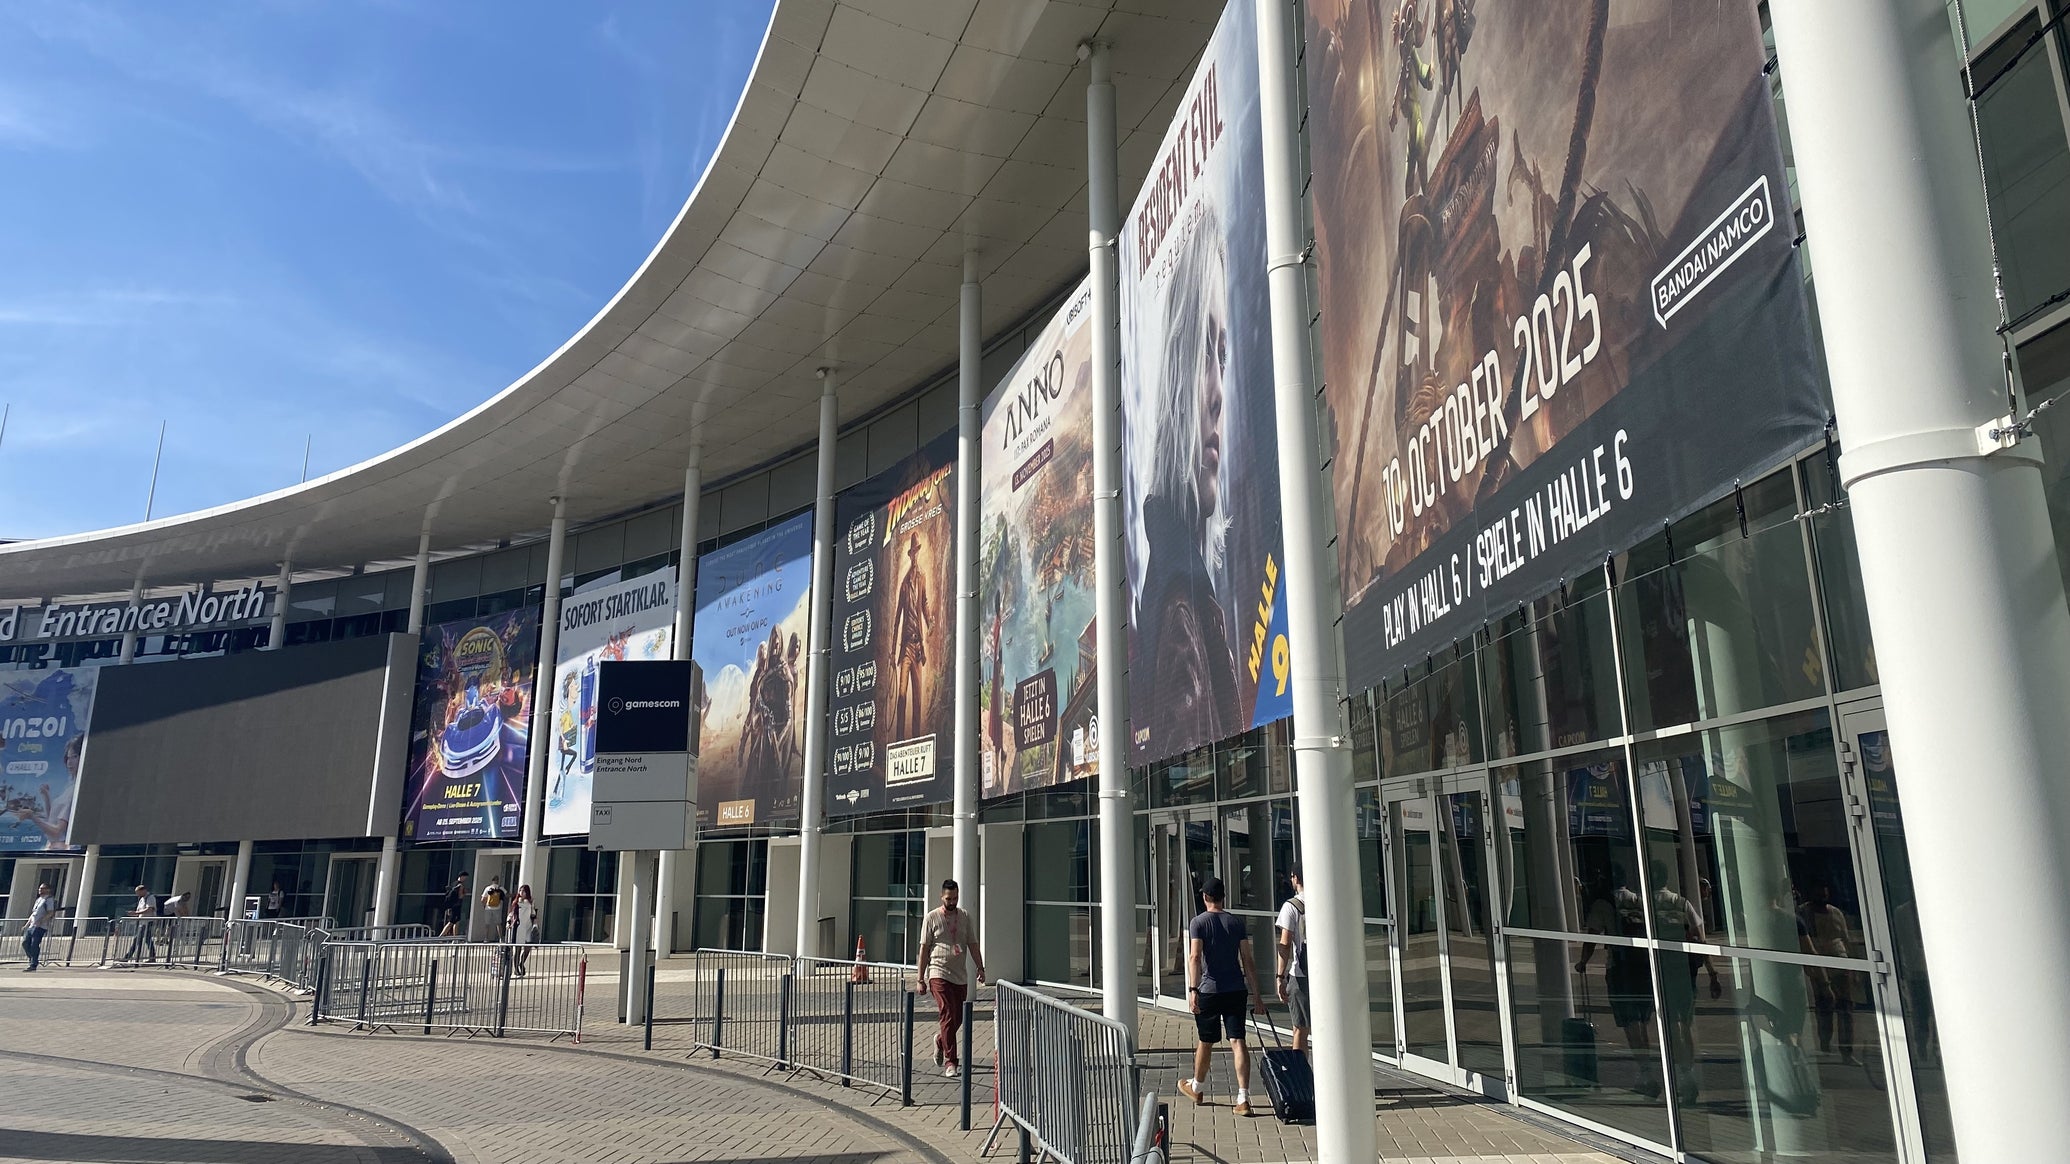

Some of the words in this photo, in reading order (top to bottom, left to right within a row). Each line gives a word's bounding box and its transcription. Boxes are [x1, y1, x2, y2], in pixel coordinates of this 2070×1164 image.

[1138, 118, 1188, 282] RESIDENT
[1191, 60, 1224, 183] EVIL
[1658, 248, 1707, 309] BANDAI
[1707, 198, 1764, 266] NAMCO
[1003, 350, 1065, 450] ANNO
[1382, 457, 1405, 541] 10
[1408, 349, 1508, 518] OCTOBER
[1513, 241, 1601, 422] 2025
[1030, 415, 1052, 445] ROMANA
[899, 513, 923, 535] GROSSE
[924, 503, 943, 521] KREIS
[1383, 592, 1406, 650] PLAY
[1407, 583, 1420, 635] IN
[1420, 564, 1451, 626] HALL
[1451, 553, 1462, 606] 6
[1467, 543, 1471, 598] /
[1476, 507, 1525, 589] SPIELE
[1525, 491, 1546, 560] IN
[1547, 444, 1612, 545] HALLE
[1614, 428, 1634, 500] 6
[37, 603, 172, 639] Entrance
[174, 581, 266, 627] North
[564, 598, 604, 631] SOFORT
[605, 581, 669, 621] STARTKLAR.
[717, 578, 783, 611] AWAKENING
[726, 628, 737, 639] OUT
[737, 623, 750, 635] NOW
[751, 620, 760, 631] ON
[760, 617, 768, 628] PC
[1248, 552, 1278, 685] HALLE
[1271, 633, 1290, 697] 9
[461, 637, 494, 656] SONIC
[625, 700, 680, 711] gamescom
[1023, 680, 1038, 703] JETZT
[1038, 677, 1046, 695] IN
[1020, 699, 1044, 727] HALLE
[1045, 695, 1051, 718] 6
[1024, 723, 1045, 744] SPIELEN
[597, 757, 624, 765] Eingang
[893, 757, 919, 777] HALLE
[921, 756, 926, 772] 7
[444, 783, 473, 799] HALLE
[474, 783, 481, 797] 7
[722, 806, 743, 819] HALLE
[744, 805, 750, 818] 6
